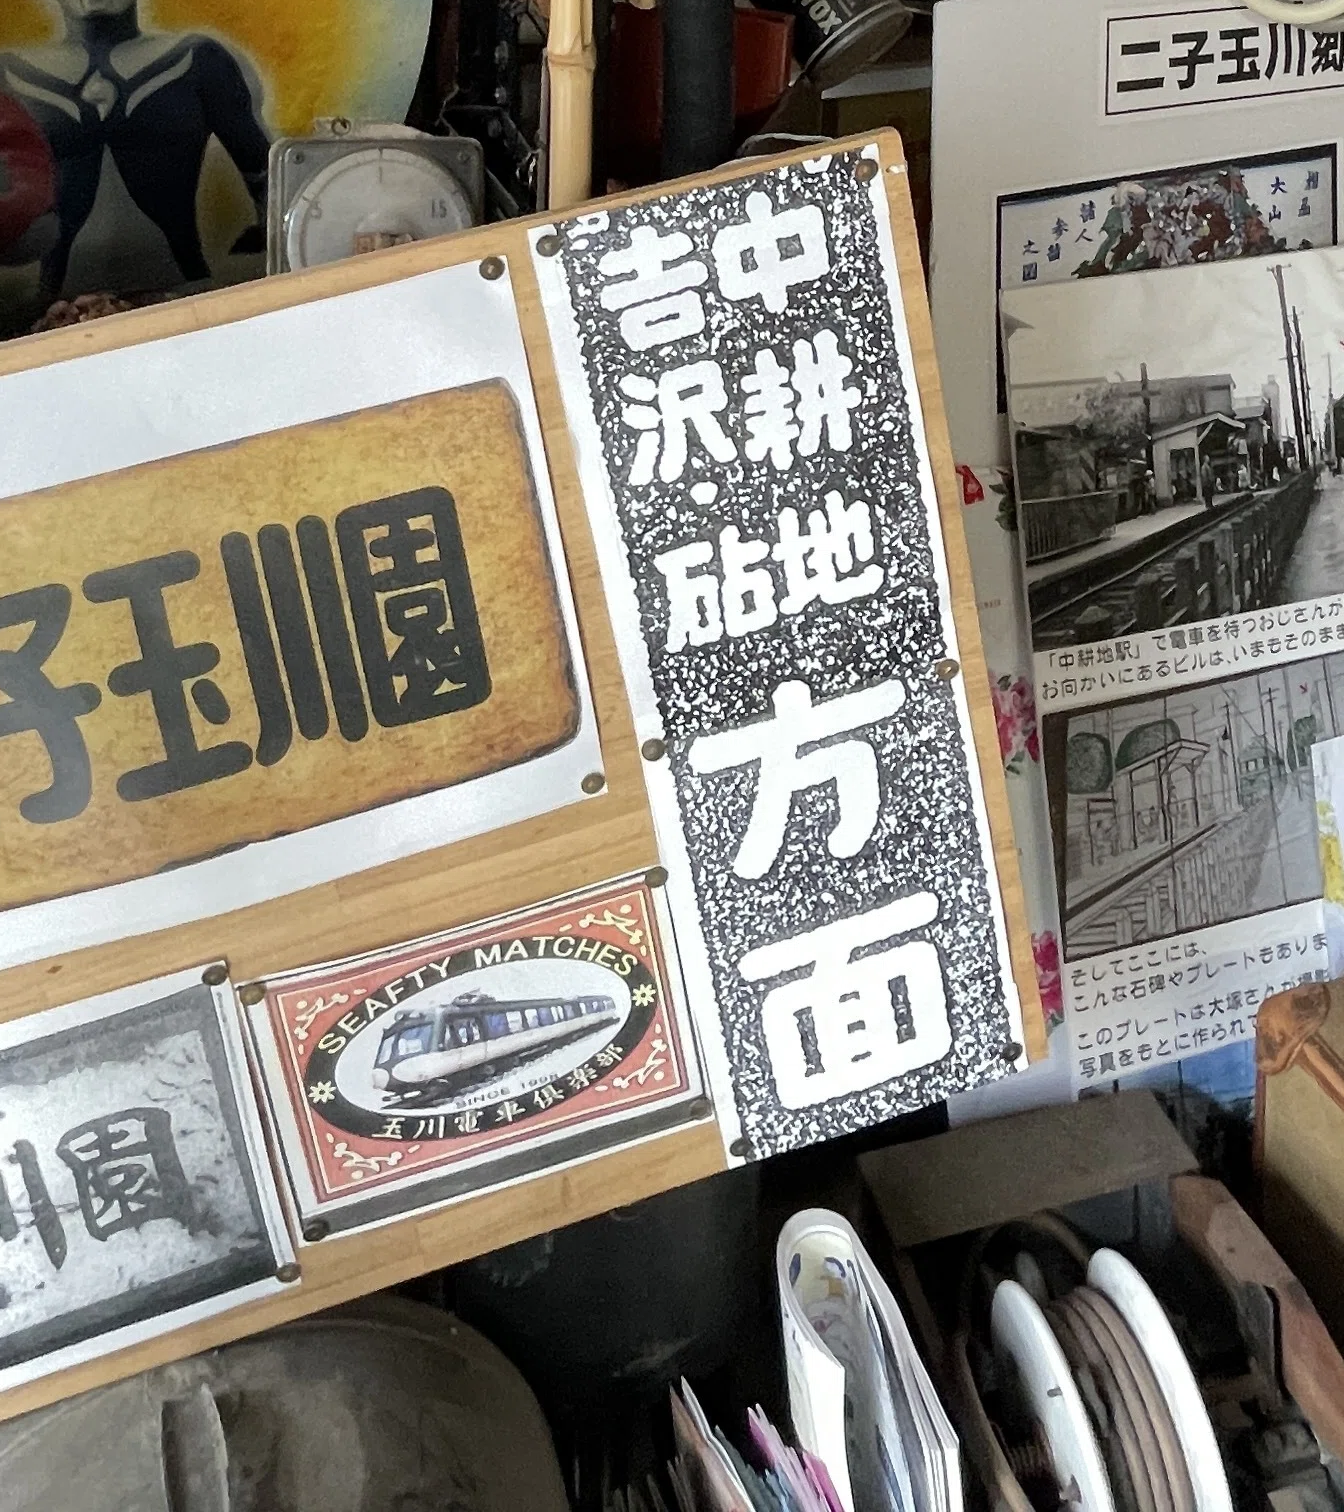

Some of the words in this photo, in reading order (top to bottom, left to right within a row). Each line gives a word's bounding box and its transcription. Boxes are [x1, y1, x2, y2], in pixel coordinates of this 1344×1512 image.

[711, 190, 885, 616] 中耕地
[687, 679, 955, 1112] 方面
[317, 955, 453, 1055] SEAFTY
[473, 935, 639, 976] MATCHES
[1071, 942, 1208, 988] そしてここには、
[1074, 933, 1328, 1013] こんな石碑やプレートもありま
[455, 1086, 511, 1109] SINCE
